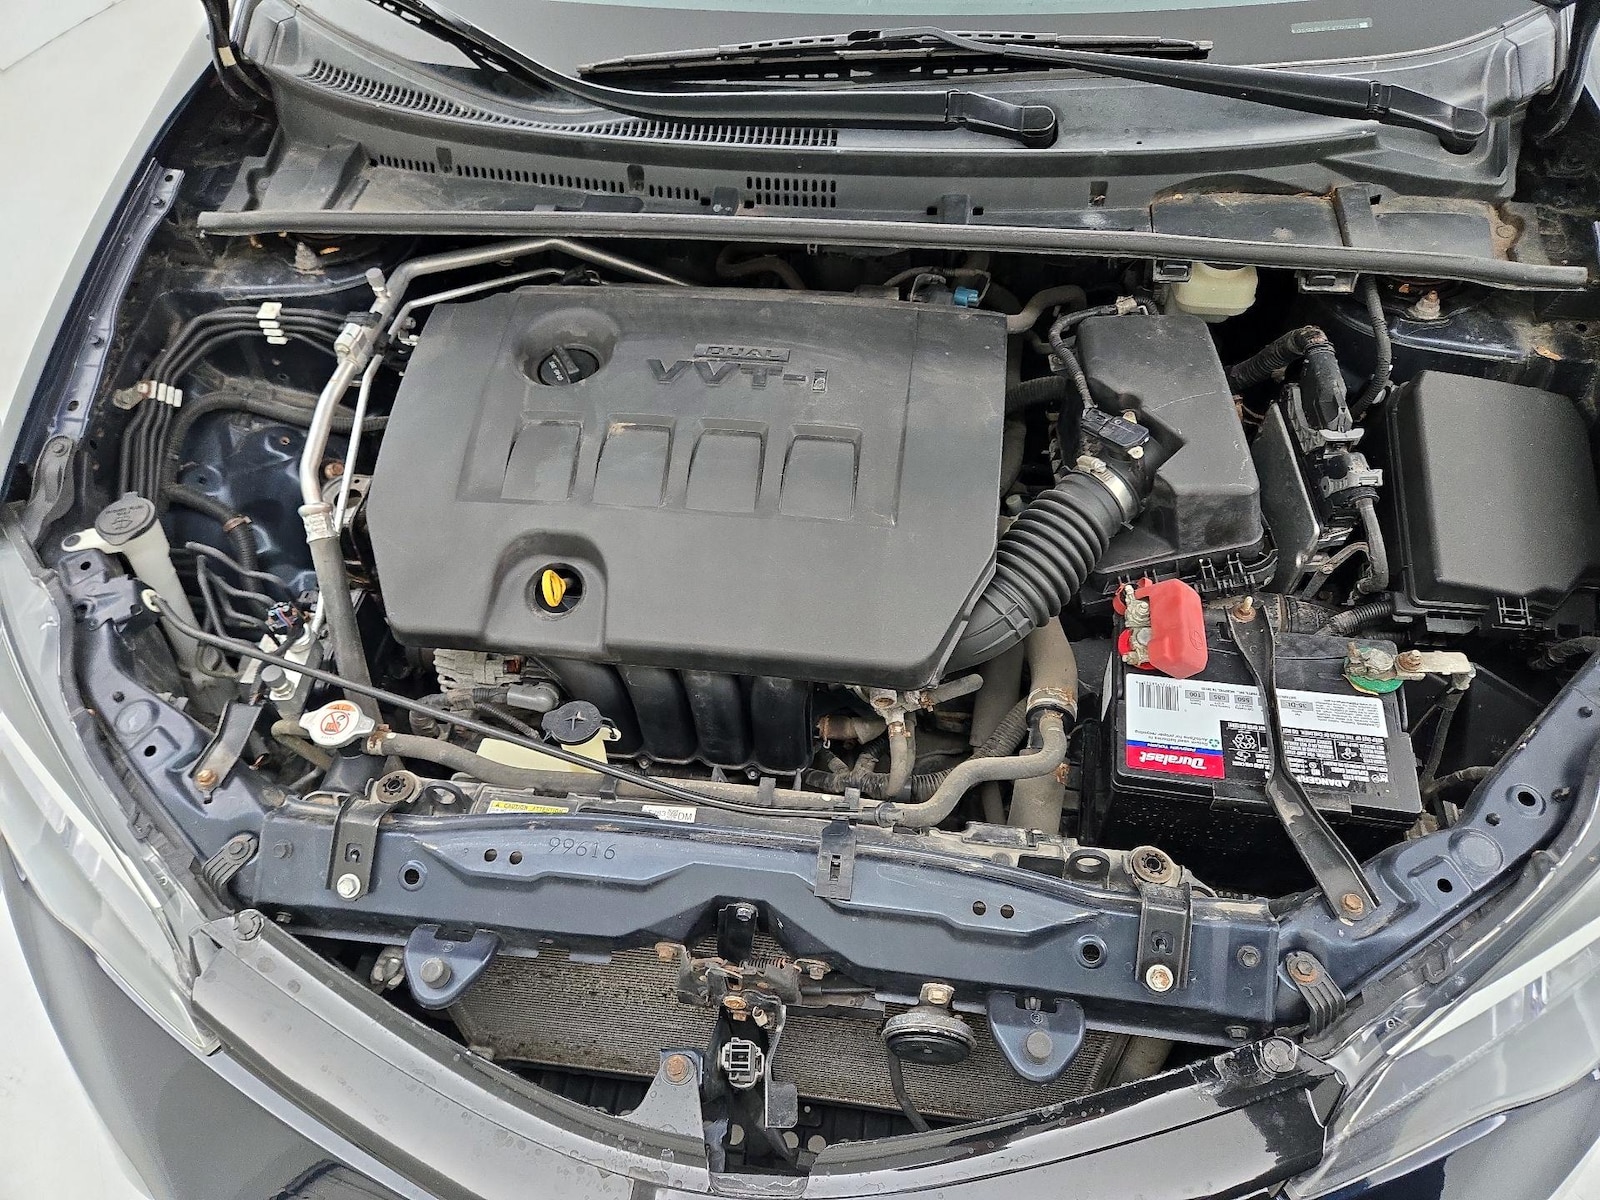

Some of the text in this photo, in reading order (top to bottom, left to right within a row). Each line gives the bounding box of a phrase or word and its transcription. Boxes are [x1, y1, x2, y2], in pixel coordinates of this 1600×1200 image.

[704, 345, 783, 359] DUAL
[1139, 751, 1207, 770] Duralast
[504, 803, 528, 811] CAUTION
[549, 836, 616, 860] 99616
